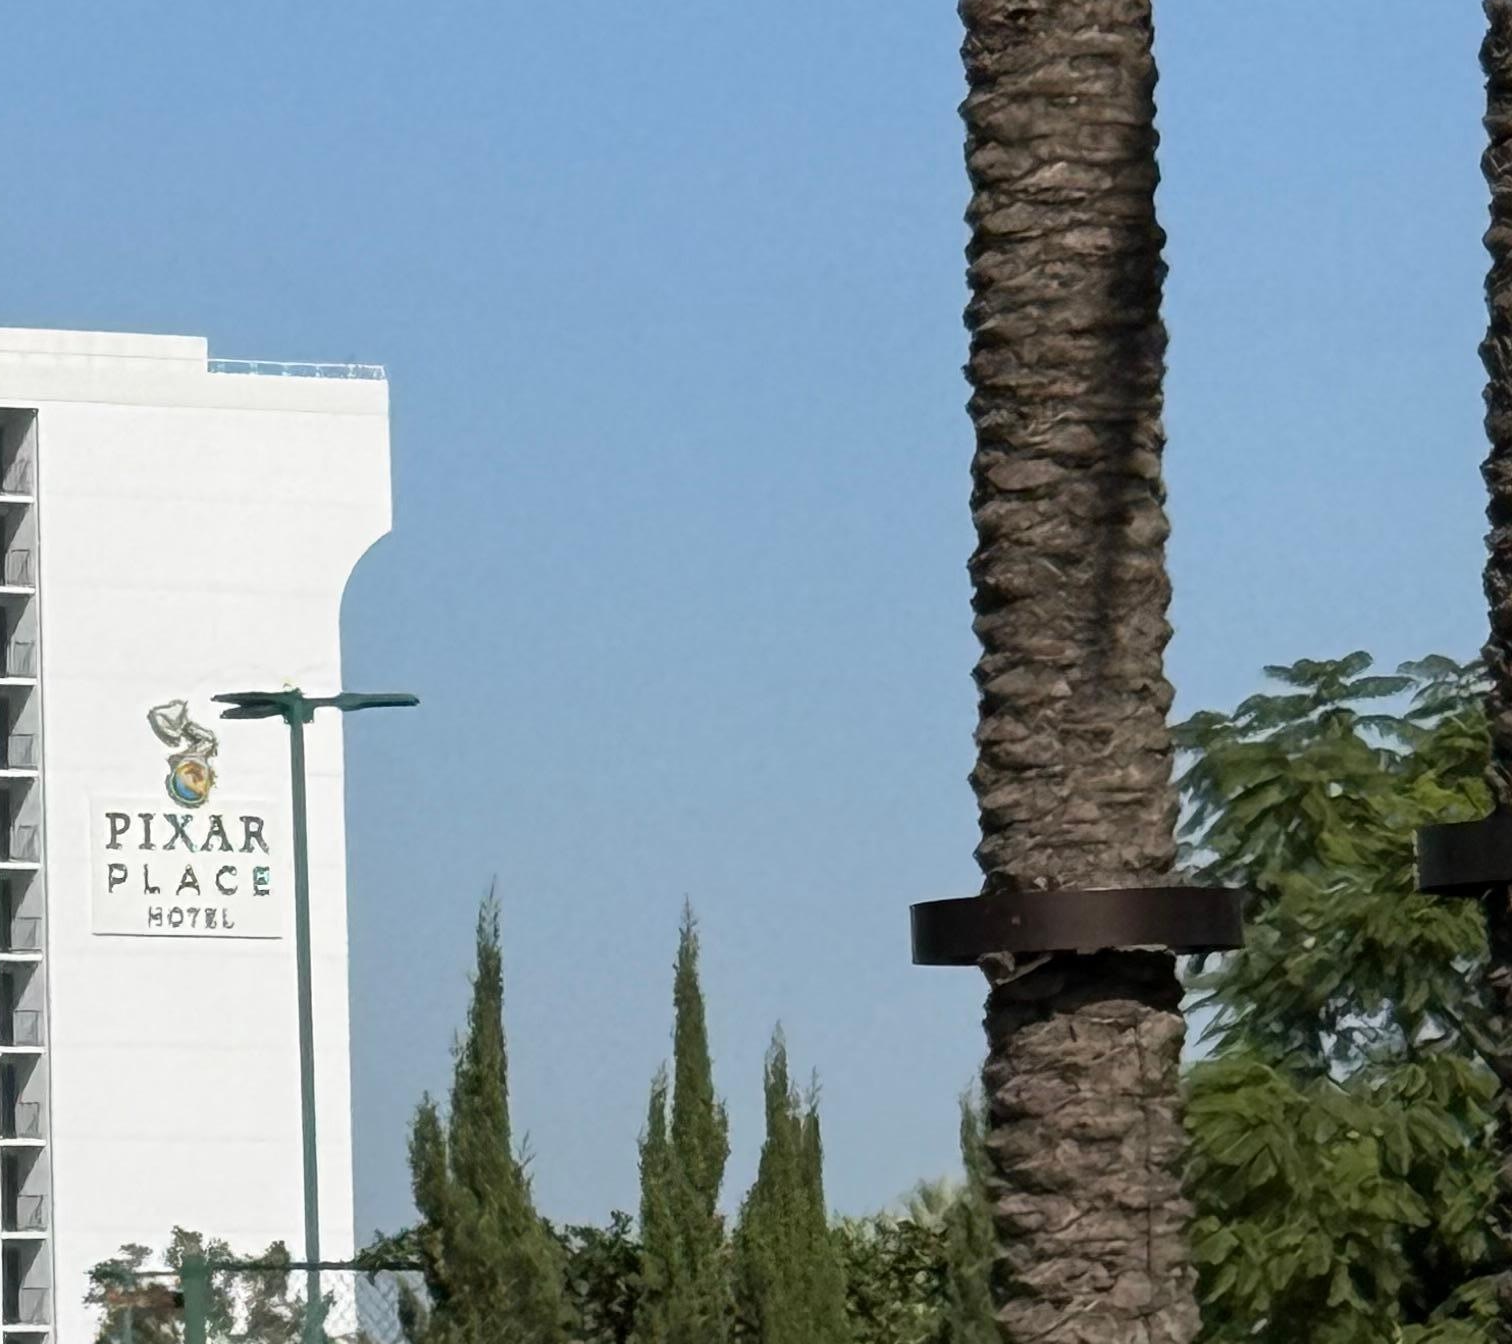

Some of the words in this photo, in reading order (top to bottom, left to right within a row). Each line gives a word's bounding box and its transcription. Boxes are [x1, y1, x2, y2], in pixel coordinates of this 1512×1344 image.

[105, 812, 270, 855] PIXAR
[107, 863, 270, 896] PLACE
[148, 906, 235, 929] HOTEL
